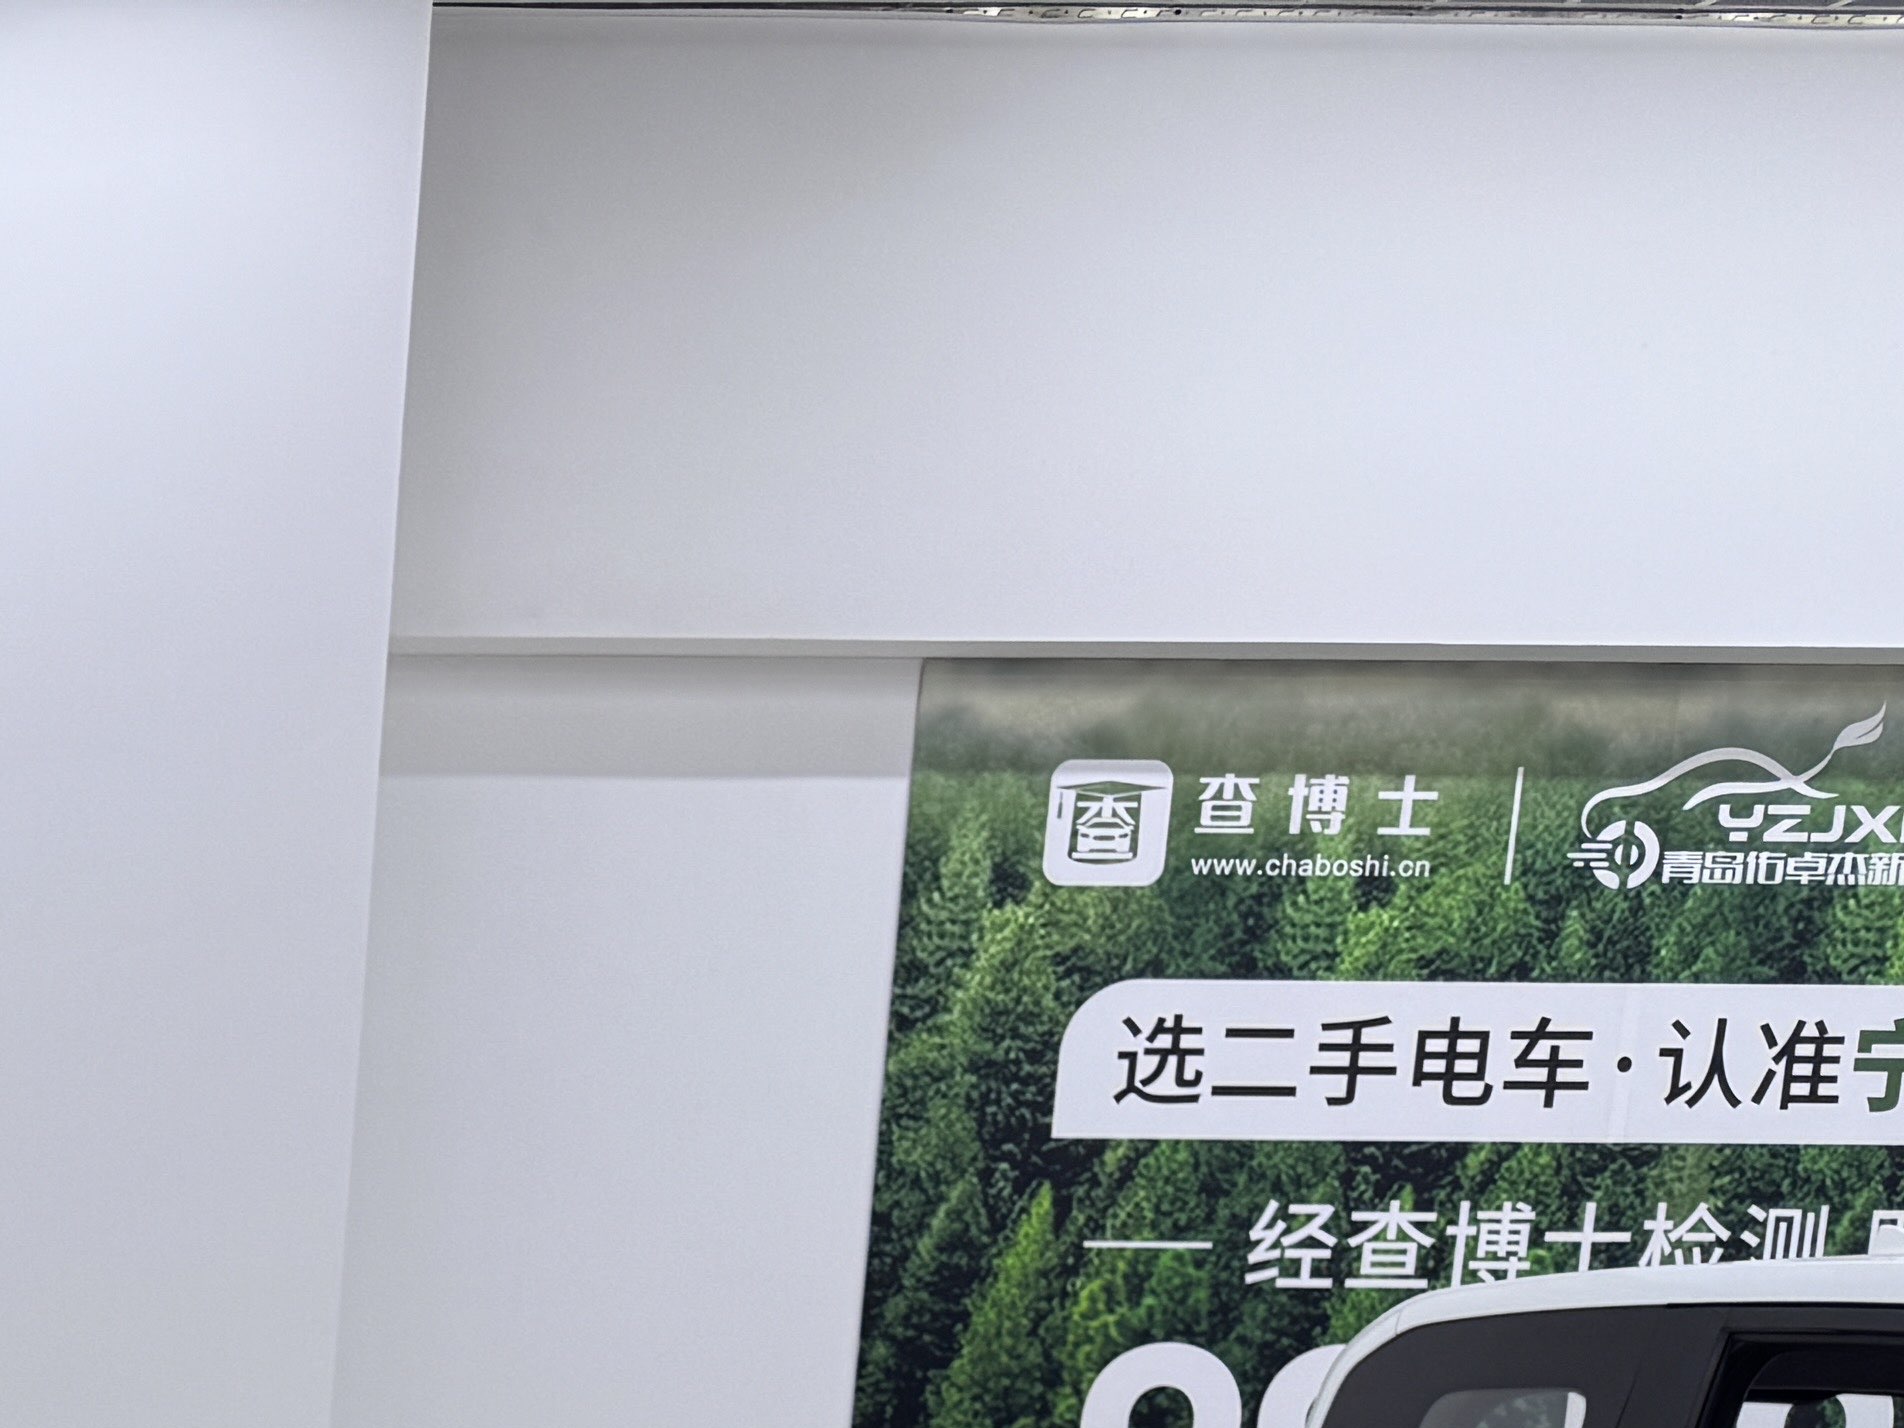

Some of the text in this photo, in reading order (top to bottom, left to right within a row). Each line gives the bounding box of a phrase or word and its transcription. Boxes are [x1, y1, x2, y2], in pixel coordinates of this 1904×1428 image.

[1194, 773, 1439, 836] 查博士
[1718, 804, 1904, 844] YZJX
[1191, 853, 1431, 878] www.chaboshi.cn
[1662, 851, 1904, 886] 青岛佑卓杰新
